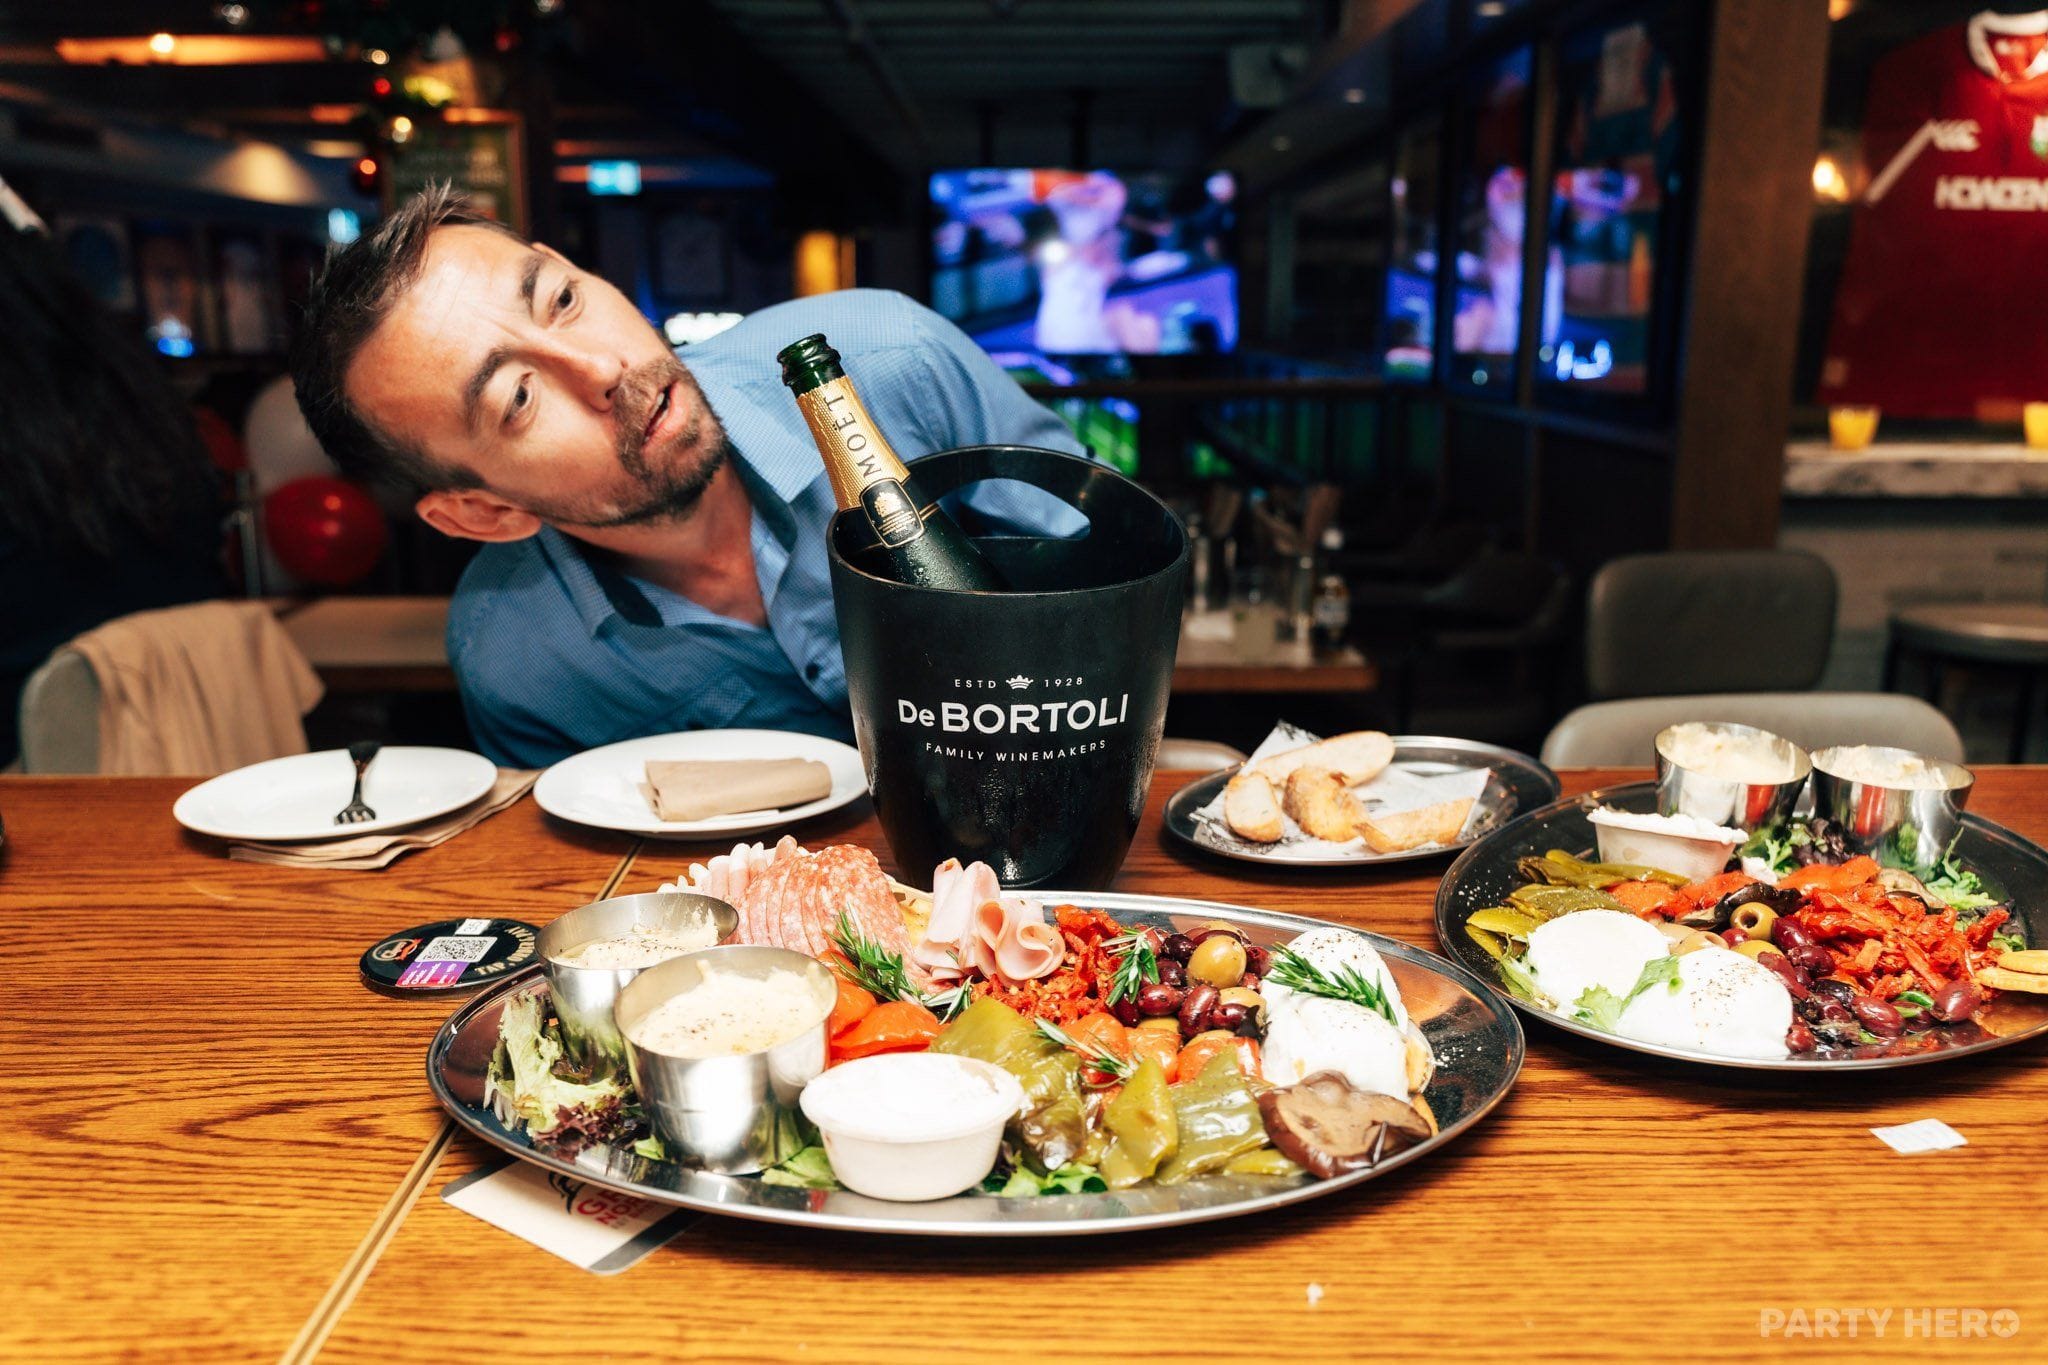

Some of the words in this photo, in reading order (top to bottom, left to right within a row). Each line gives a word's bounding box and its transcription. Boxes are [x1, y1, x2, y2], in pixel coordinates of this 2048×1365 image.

[823, 393, 882, 478] MOËT
[954, 678, 997, 690] ESTD
[1044, 676, 1084, 688] 1928
[897, 699, 936, 727] De
[941, 693, 1129, 734] BORTOLI
[926, 742, 985, 761] FAMILY
[996, 739, 1107, 762] WINEMAKERS
